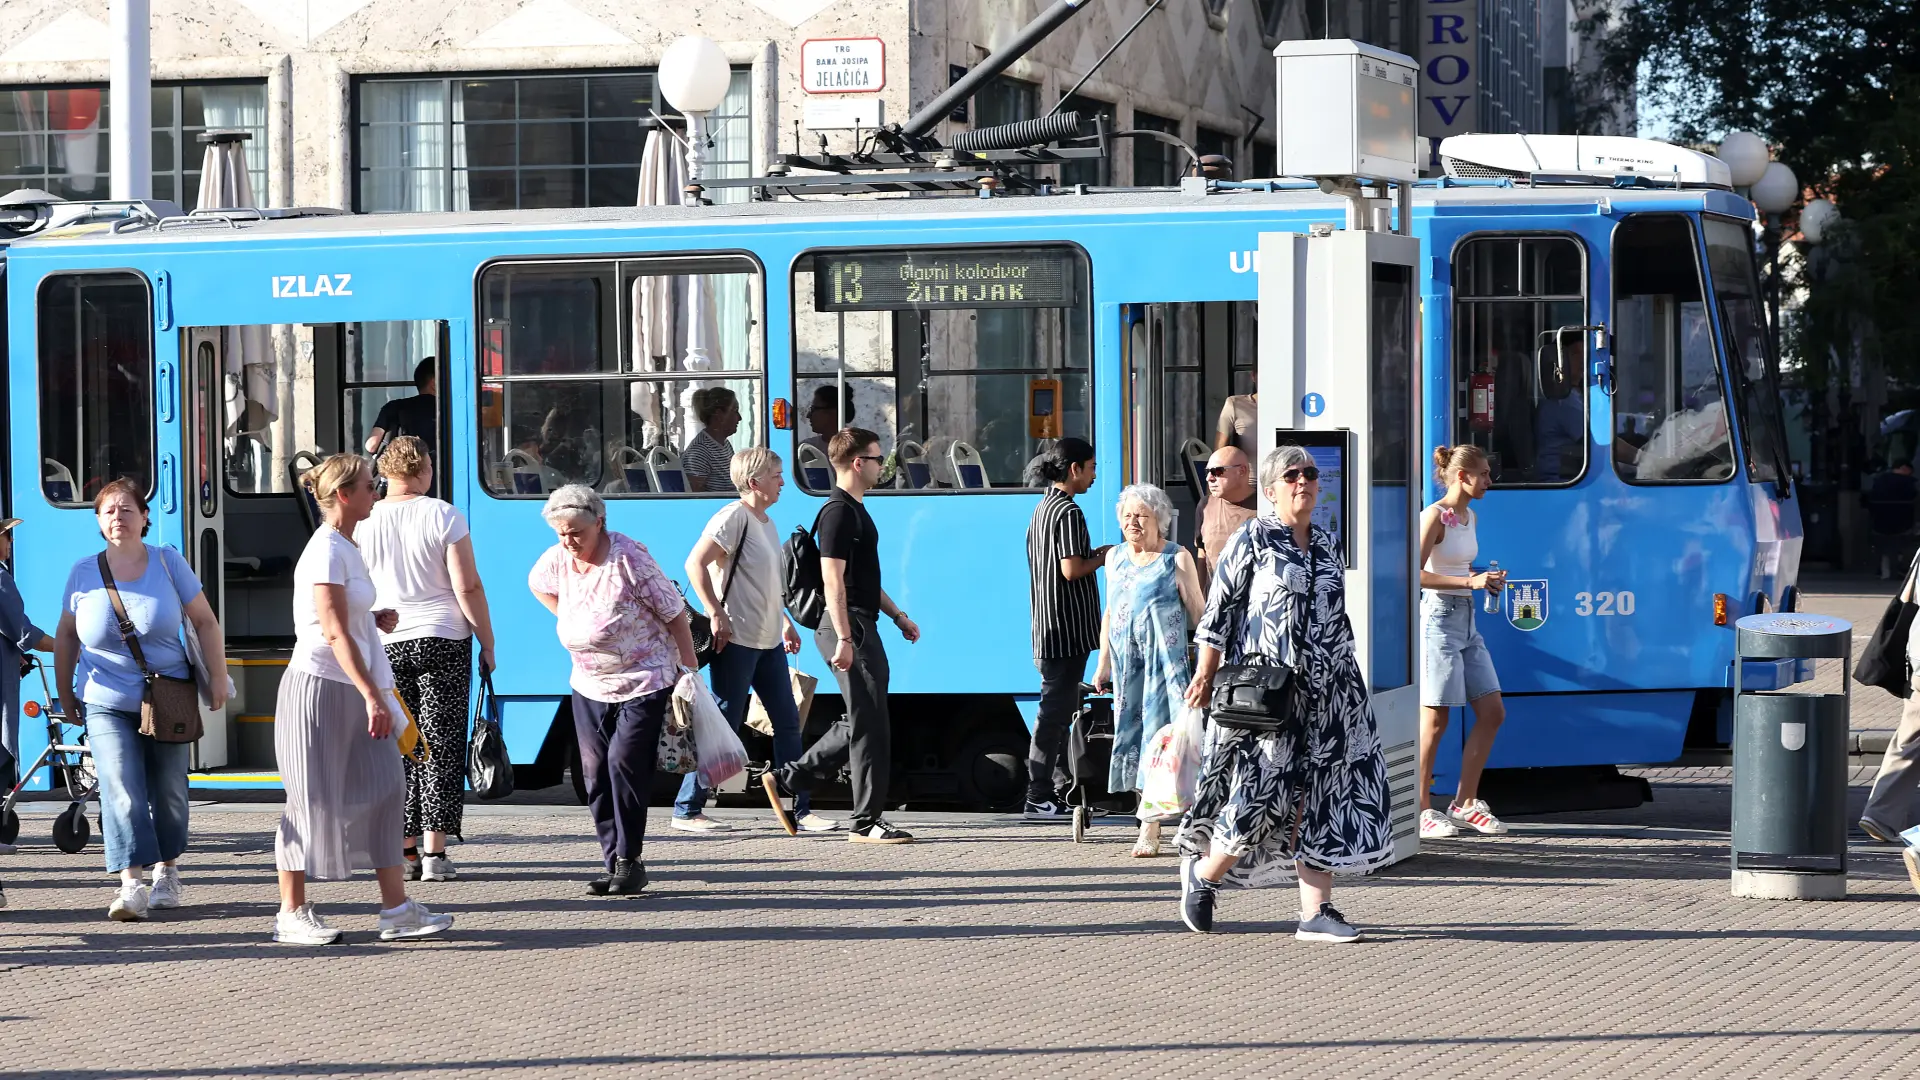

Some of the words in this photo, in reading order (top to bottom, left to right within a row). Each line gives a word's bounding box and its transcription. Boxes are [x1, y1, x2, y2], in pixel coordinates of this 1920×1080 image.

[835, 45, 851, 53] TRG
[816, 58, 837, 66] BANA
[841, 57, 869, 65] JOSIPA
[816, 68, 869, 87] JELAČIĆA
[1424, 0, 1471, 166] ROV
[900, 262, 949, 281] Glavni
[955, 262, 1029, 280] kolodvor
[271, 273, 353, 298] IZLAZ
[828, 262, 863, 303] 13
[906, 281, 1024, 302] ŽITNJAK
[1574, 590, 1636, 617] 320
